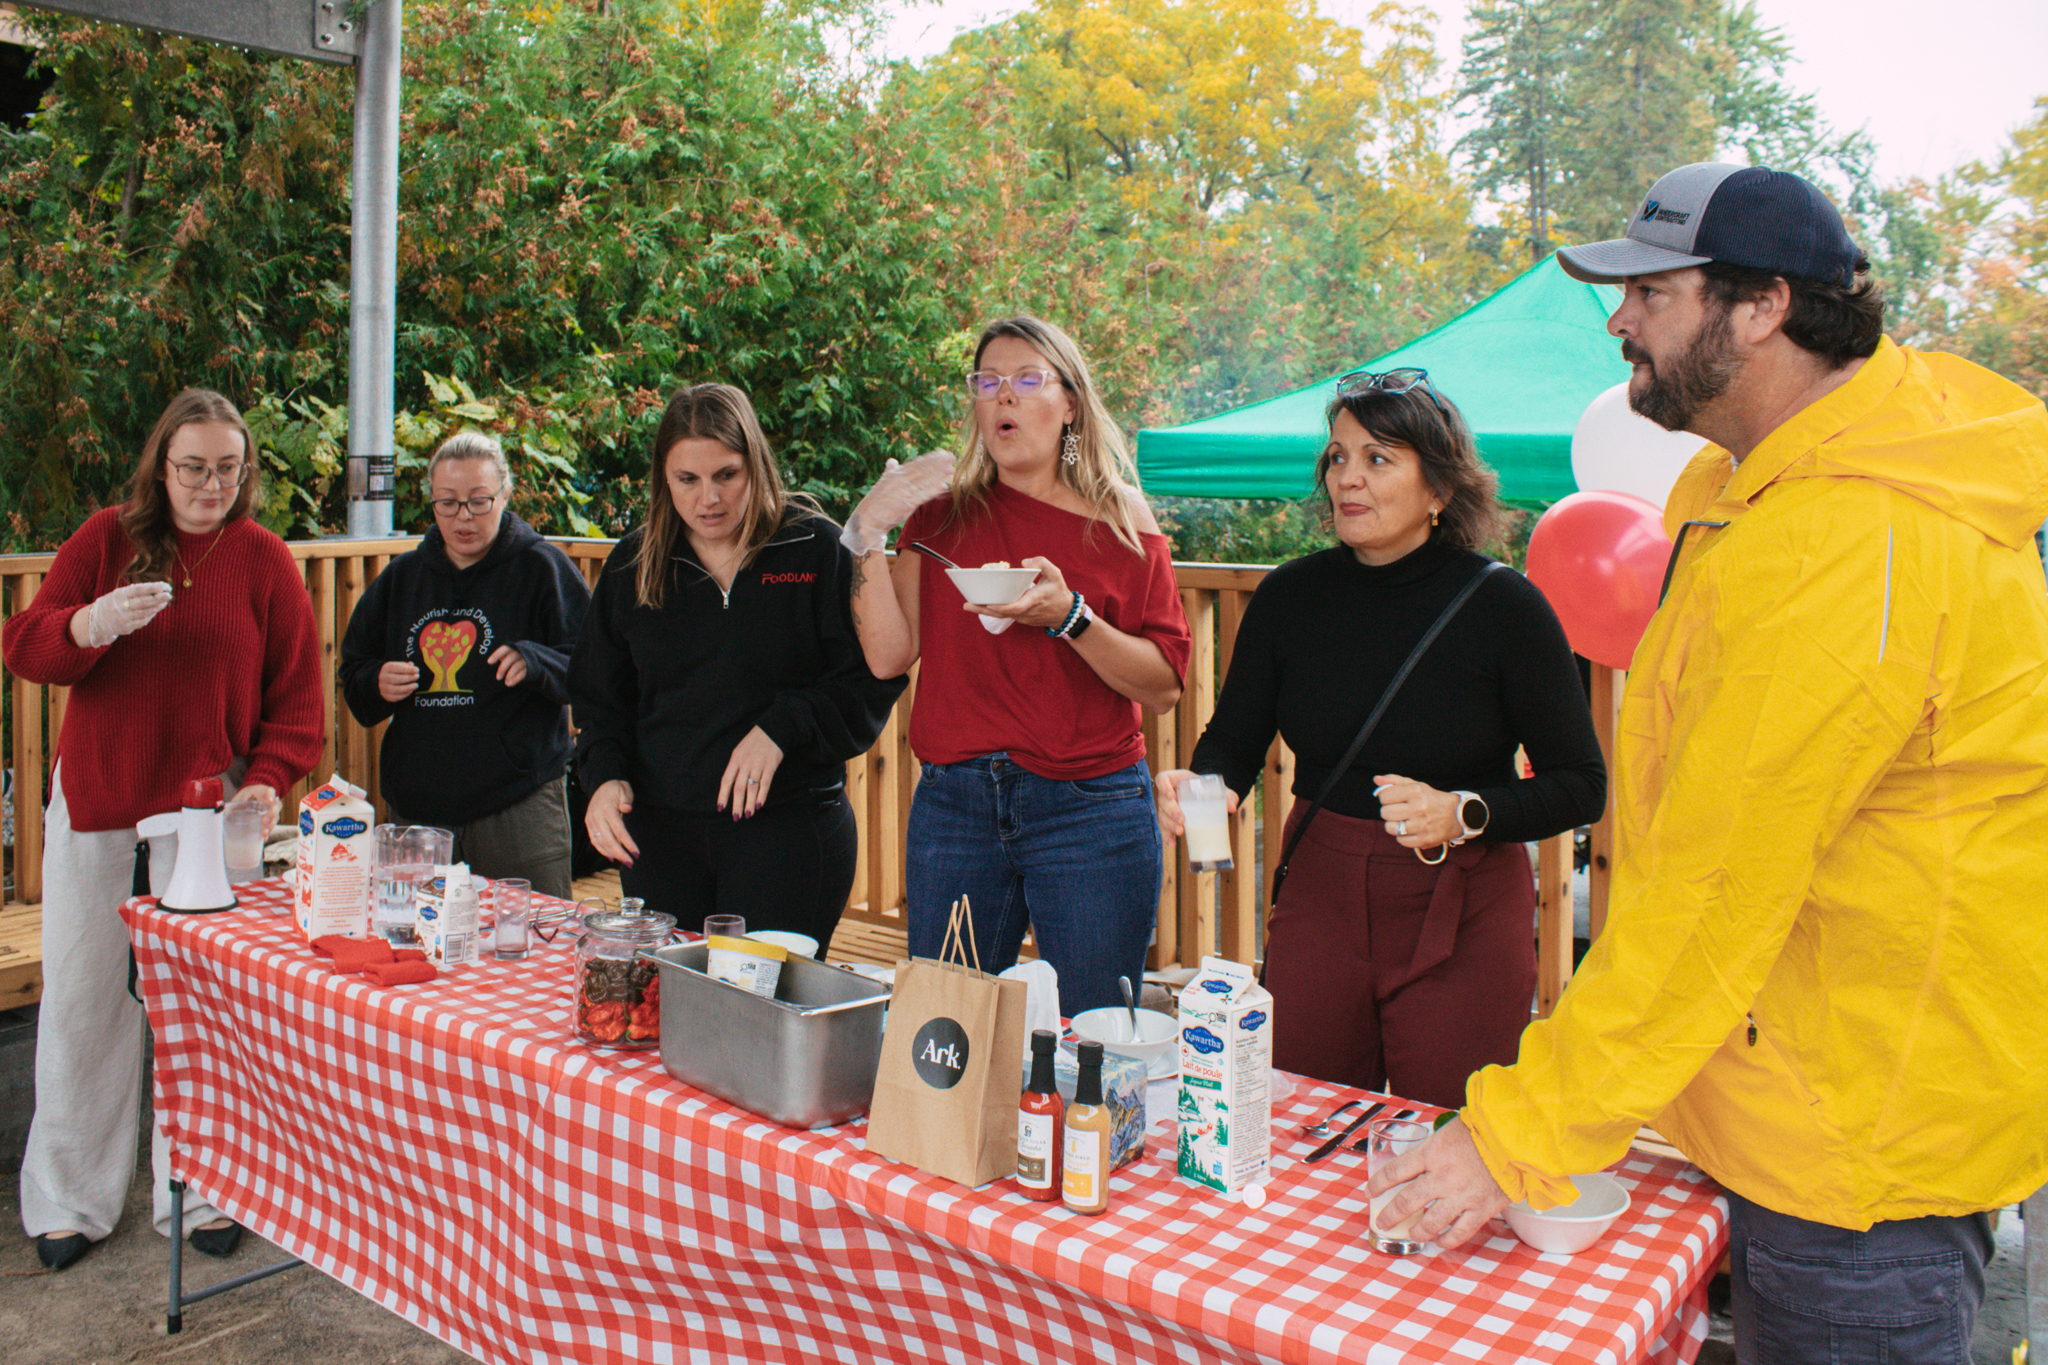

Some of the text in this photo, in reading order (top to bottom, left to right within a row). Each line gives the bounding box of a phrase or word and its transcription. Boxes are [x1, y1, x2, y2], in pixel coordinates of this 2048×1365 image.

[761, 571, 817, 585] FOODLAN
[473, 609, 495, 655] Develop
[414, 695, 475, 707] Foundation
[325, 823, 365, 833] Kawartha
[1185, 1029, 1222, 1049] Kawartha
[1182, 1057, 1194, 1070] Lait
[1194, 1064, 1202, 1074] de
[1202, 1067, 1223, 1080] poule
